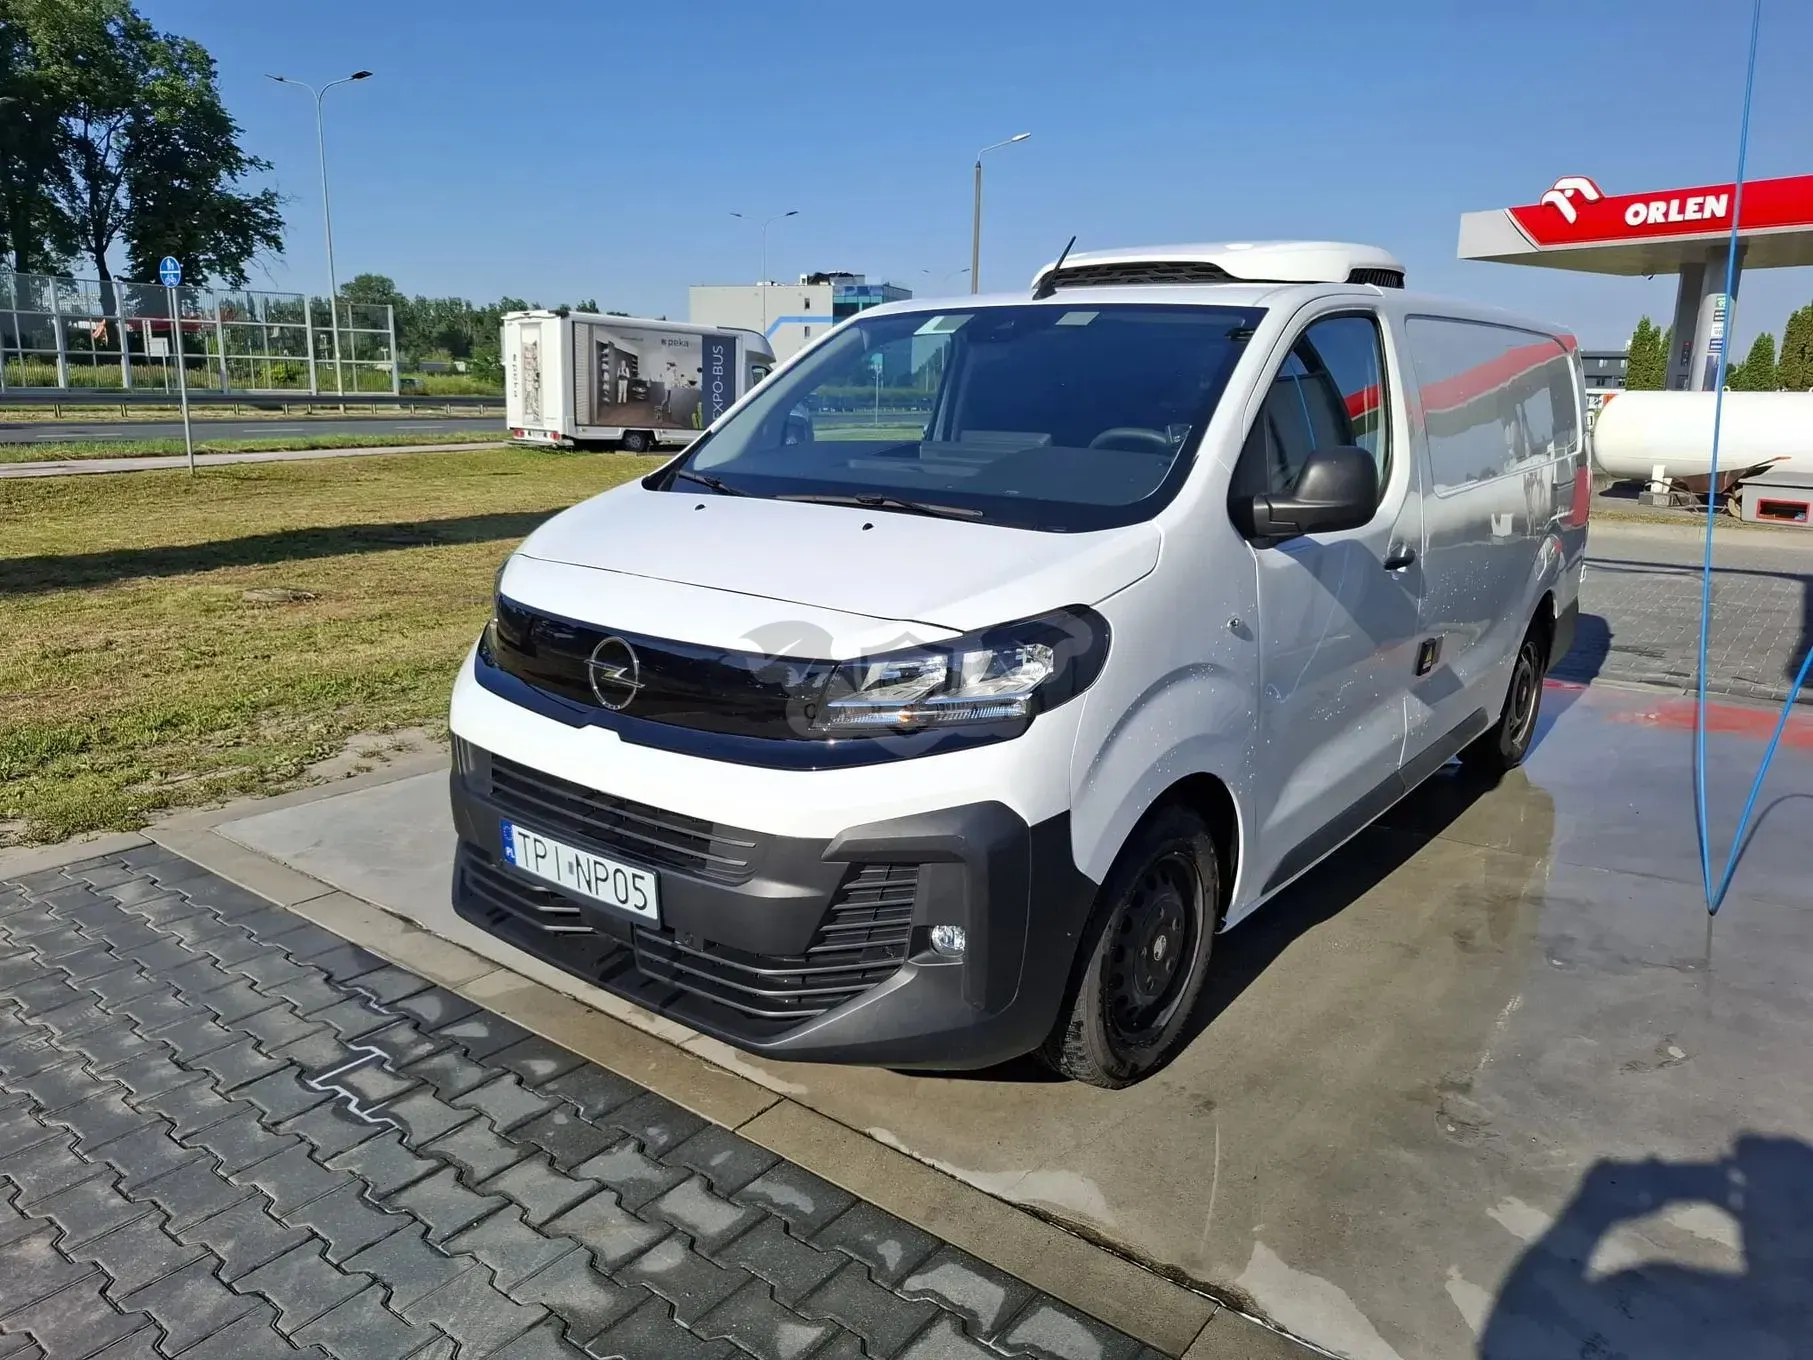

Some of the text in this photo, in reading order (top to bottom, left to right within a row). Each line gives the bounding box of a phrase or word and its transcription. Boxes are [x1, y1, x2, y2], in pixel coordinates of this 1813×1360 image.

[1625, 193, 1729, 226] ORLEN
[518, 831, 648, 911] TPI NP05
